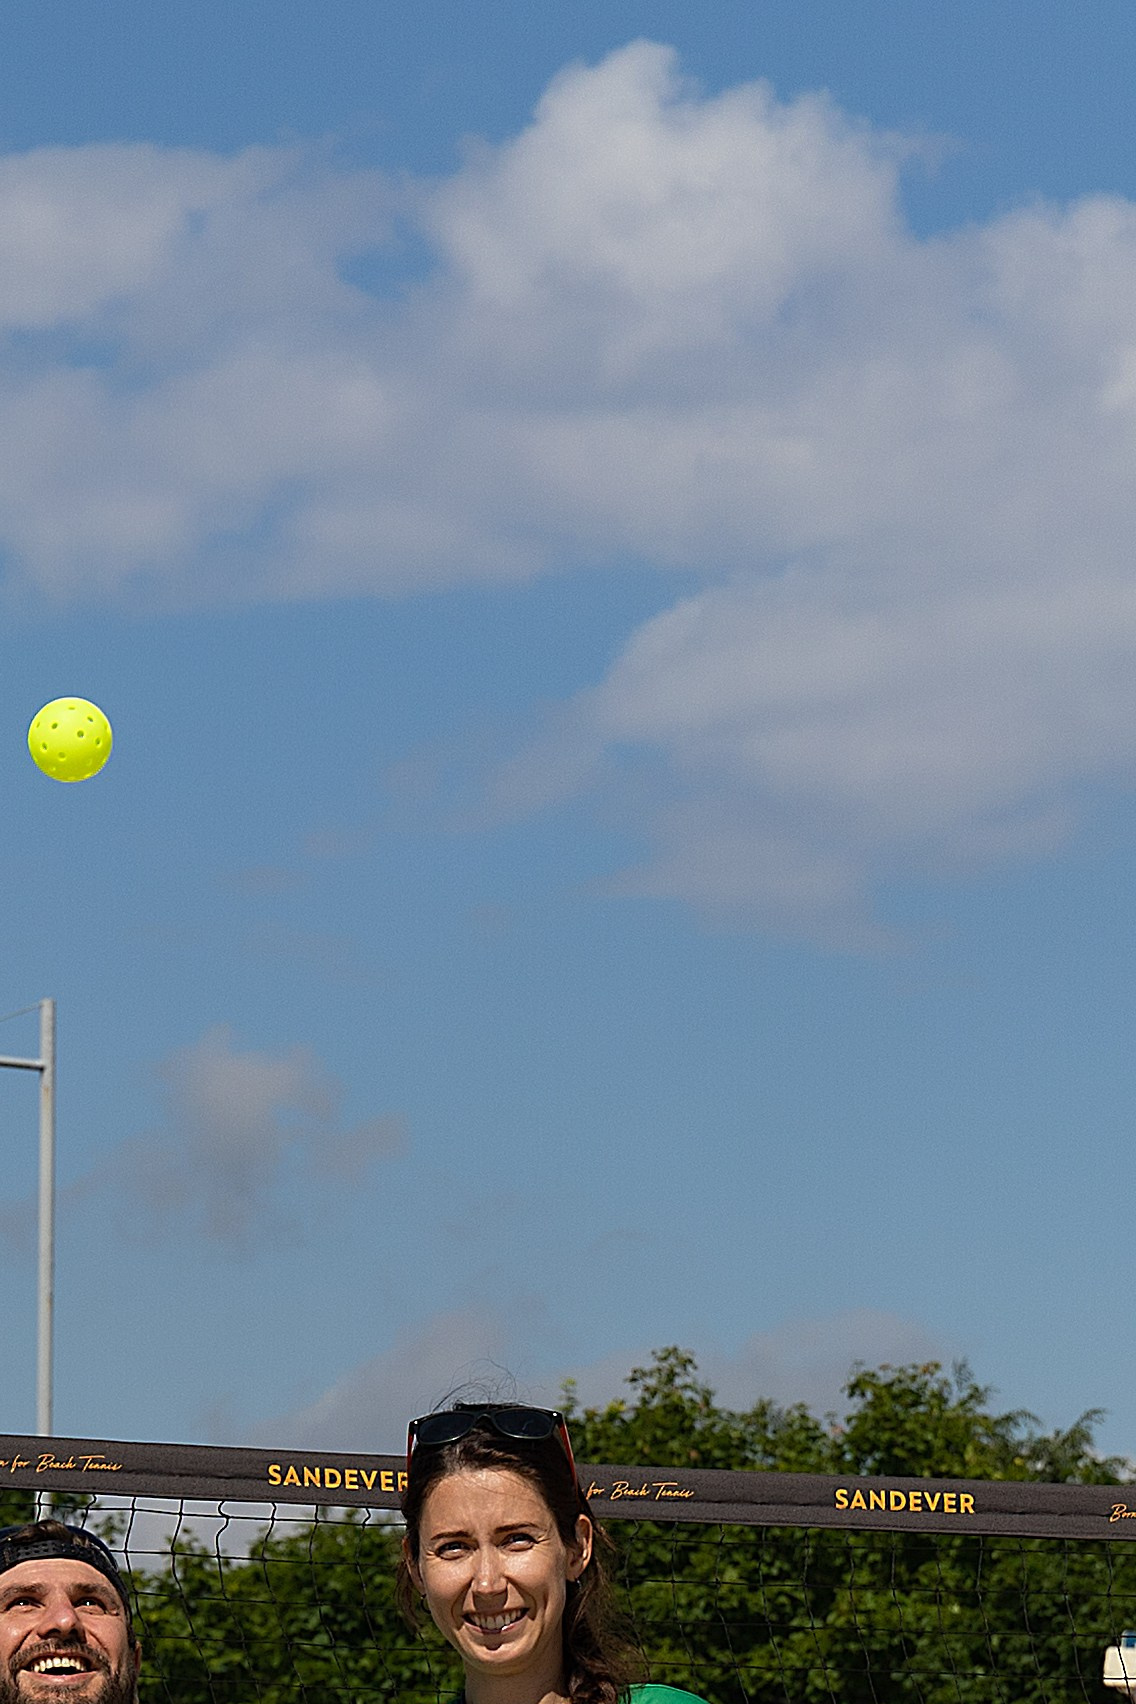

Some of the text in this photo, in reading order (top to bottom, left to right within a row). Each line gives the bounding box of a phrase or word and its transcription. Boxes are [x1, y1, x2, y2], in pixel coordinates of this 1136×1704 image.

[10, 1454, 31, 1473] for
[36, 1453, 77, 1473] Beach
[78, 1455, 124, 1473] Tennis
[585, 1480, 696, 1501] for Beach Tennis
[834, 1488, 975, 1514] SANDEVER
